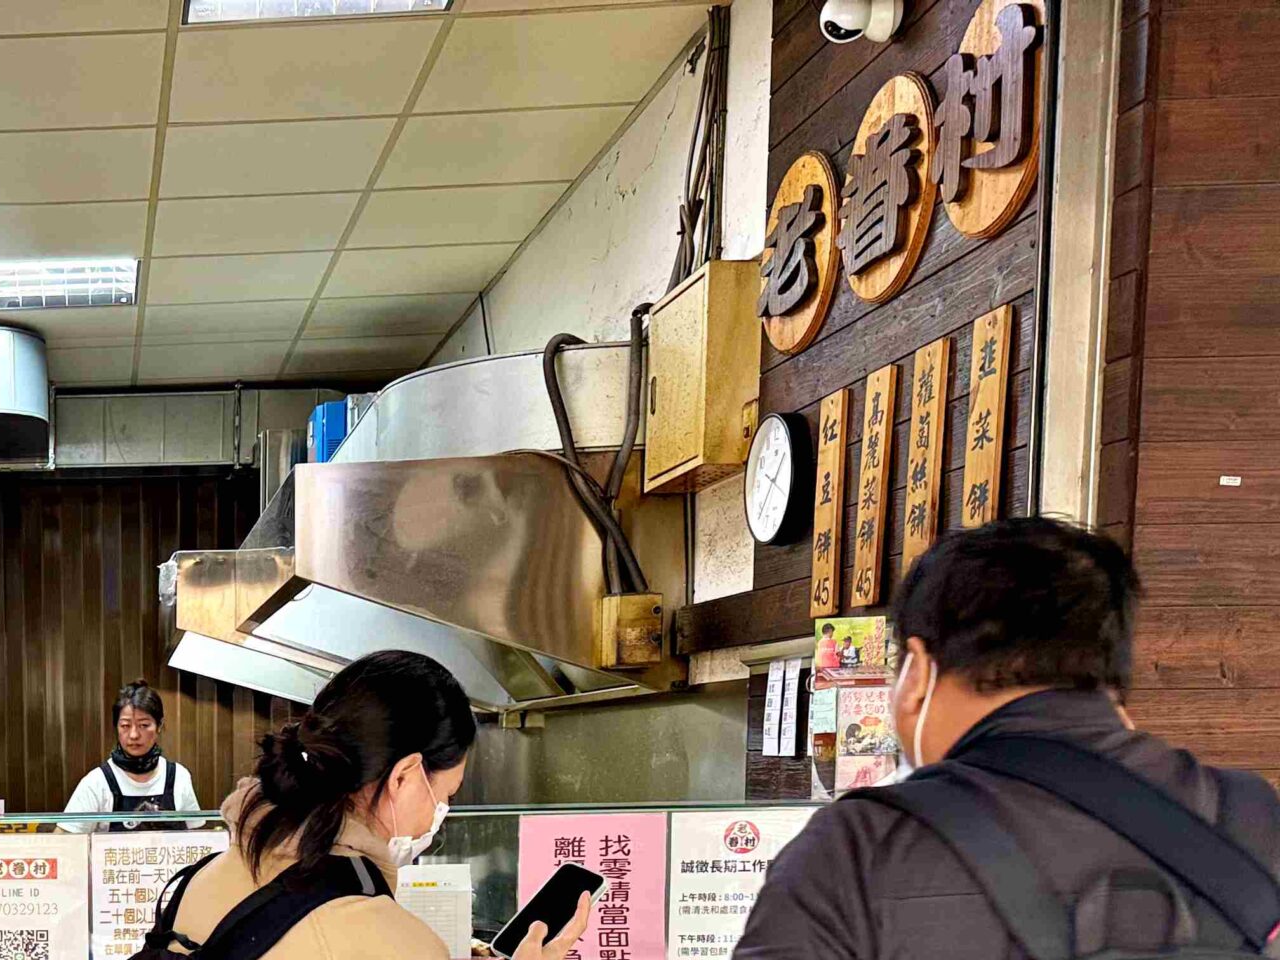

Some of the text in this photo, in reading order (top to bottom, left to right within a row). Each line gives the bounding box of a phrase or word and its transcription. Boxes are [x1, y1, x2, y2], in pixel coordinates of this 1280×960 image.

[814, 414, 838, 606] 紅豆餅 45
[855, 567, 872, 601] 45
[1, 888, 40, 897] LINE ID
